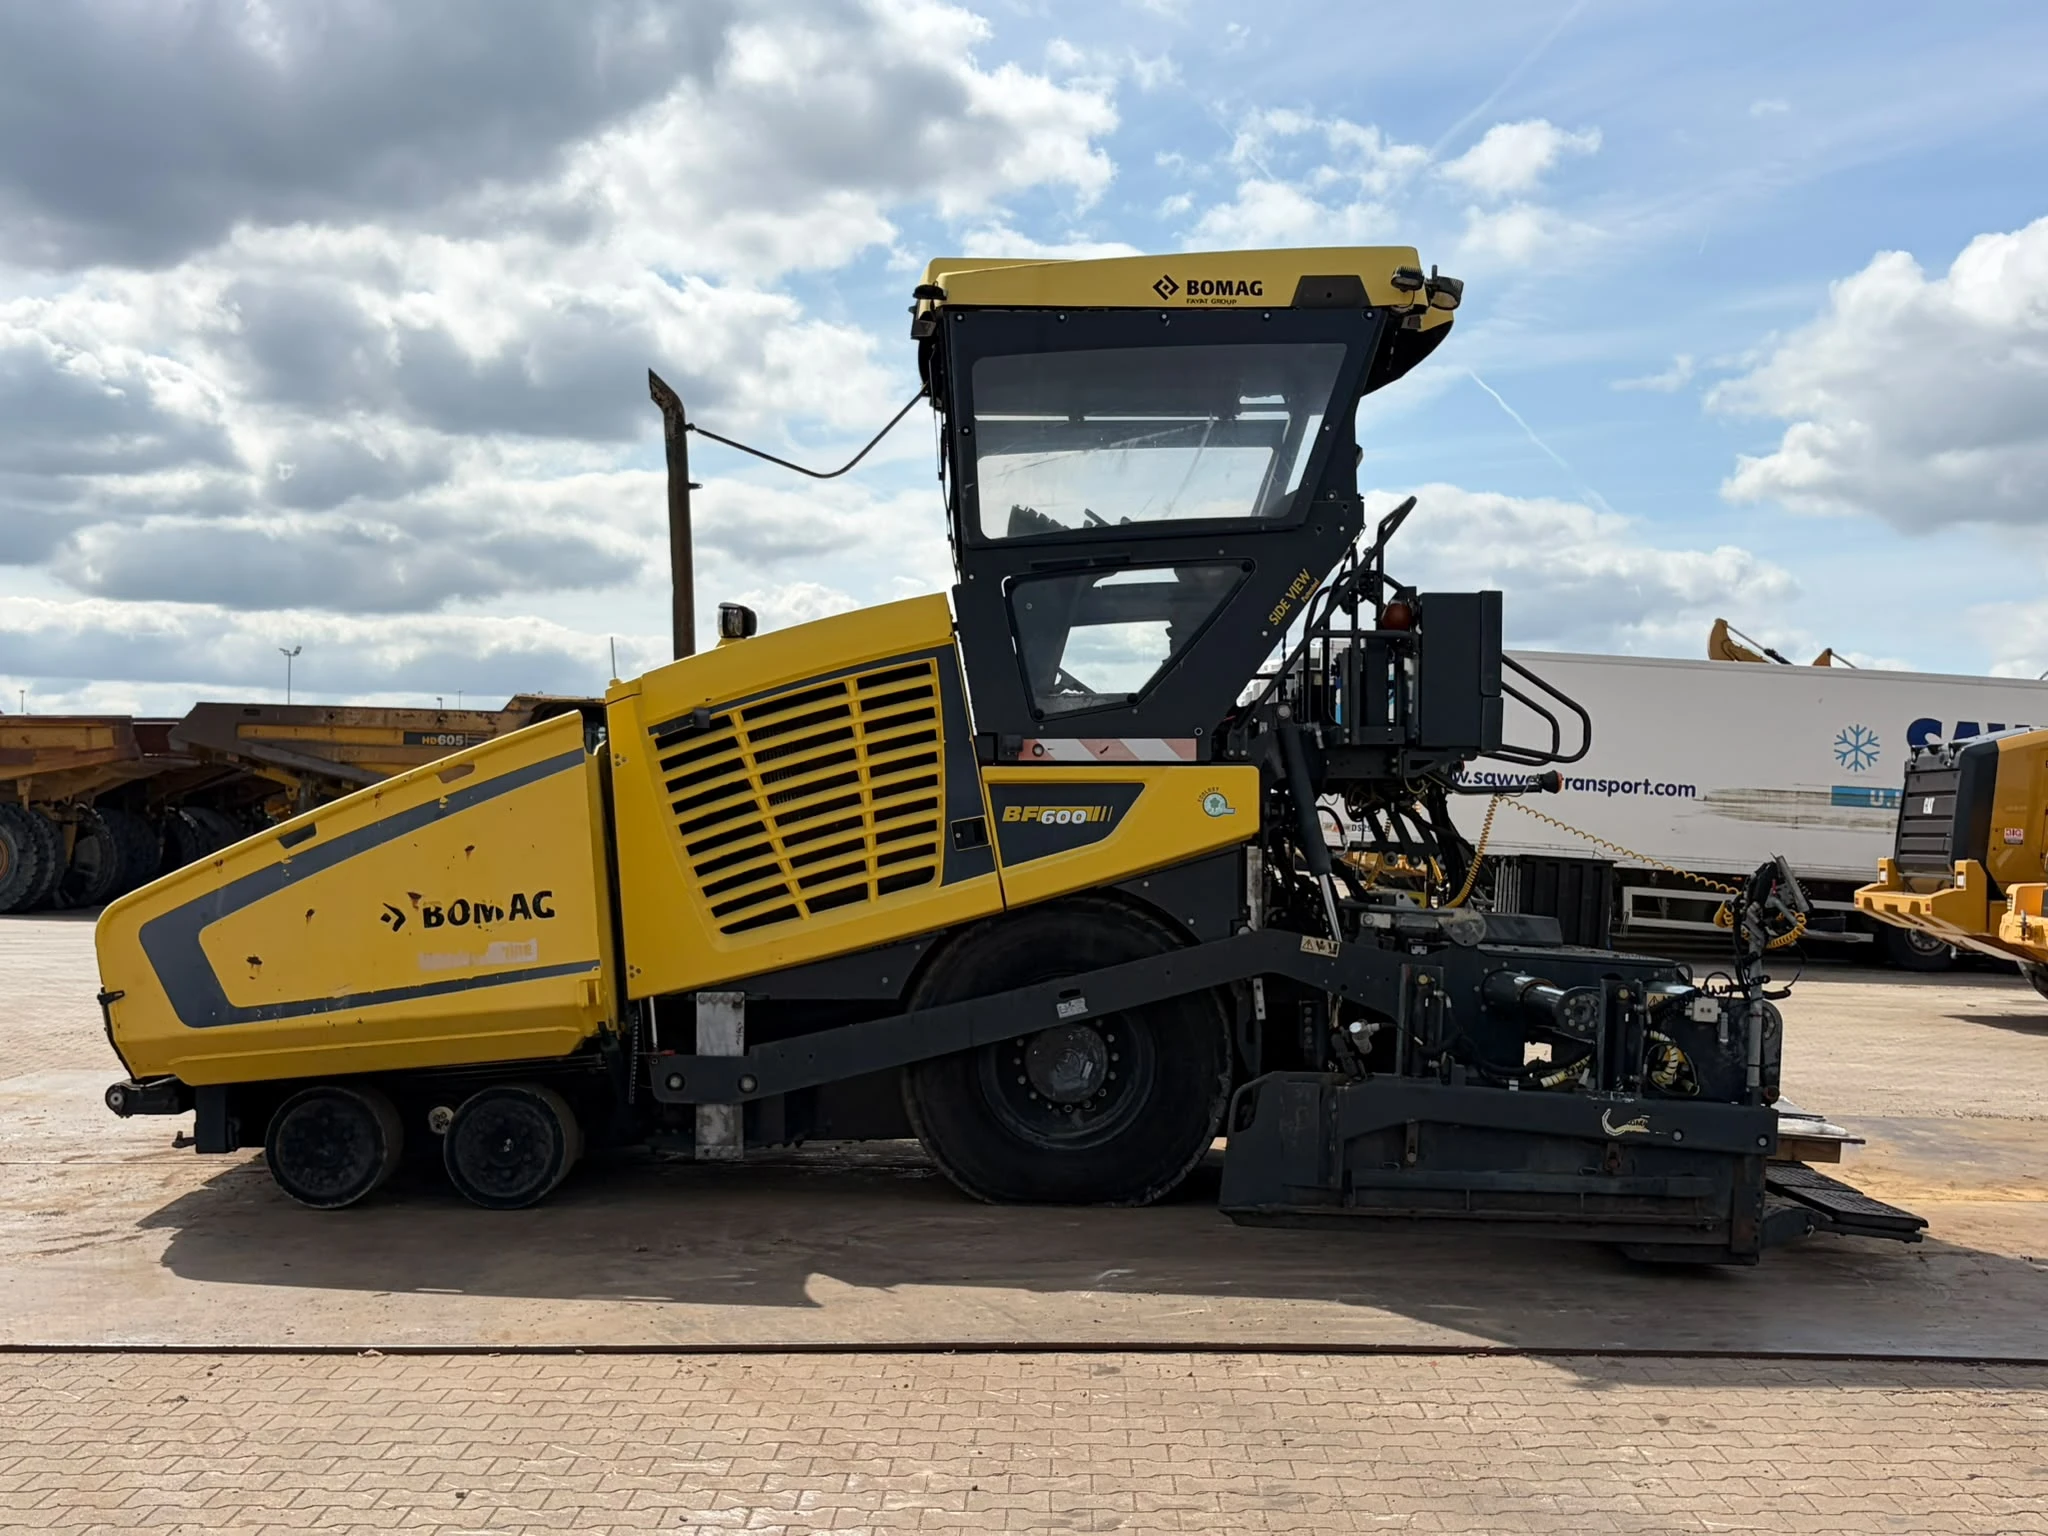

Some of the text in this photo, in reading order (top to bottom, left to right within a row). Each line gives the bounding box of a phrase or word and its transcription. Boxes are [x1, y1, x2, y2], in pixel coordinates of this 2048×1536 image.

[1186, 279, 1263, 296] BOMAG
[1268, 568, 1311, 626] SIDE VIEW
[421, 734, 464, 746] HD605
[1002, 806, 1087, 824] BF600
[422, 890, 556, 929] BOMAG
